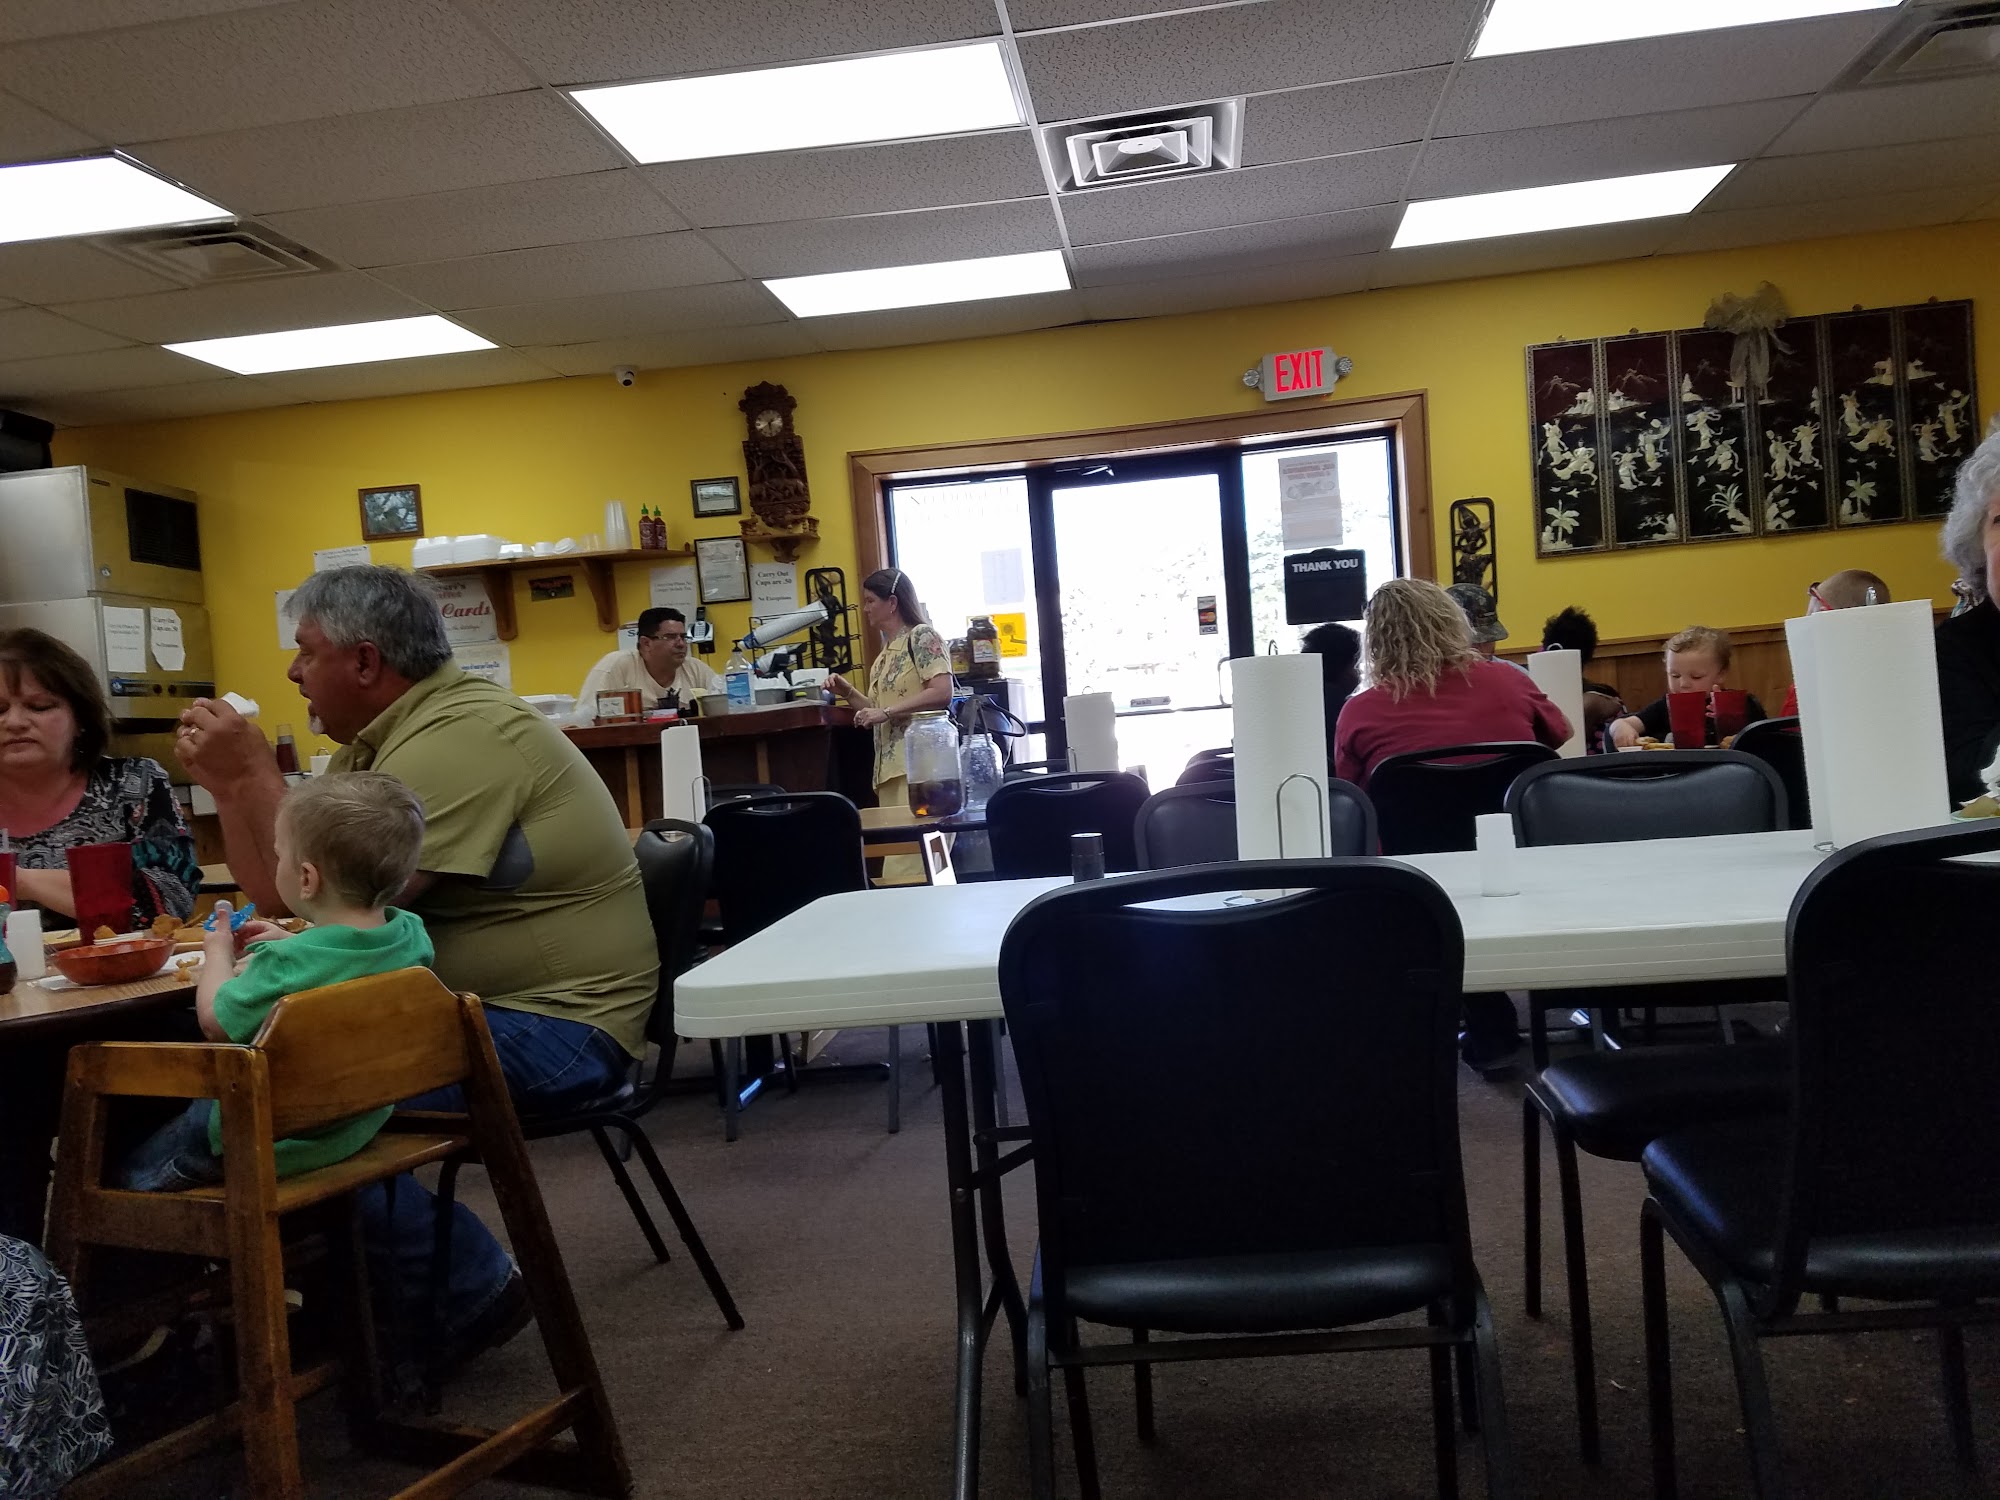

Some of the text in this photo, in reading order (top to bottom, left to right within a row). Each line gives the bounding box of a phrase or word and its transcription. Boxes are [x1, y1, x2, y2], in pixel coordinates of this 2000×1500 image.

[1274, 349, 1324, 393] EXIT
[1292, 558, 1359, 573] THANK YOU
[441, 601, 491, 619] Cards
